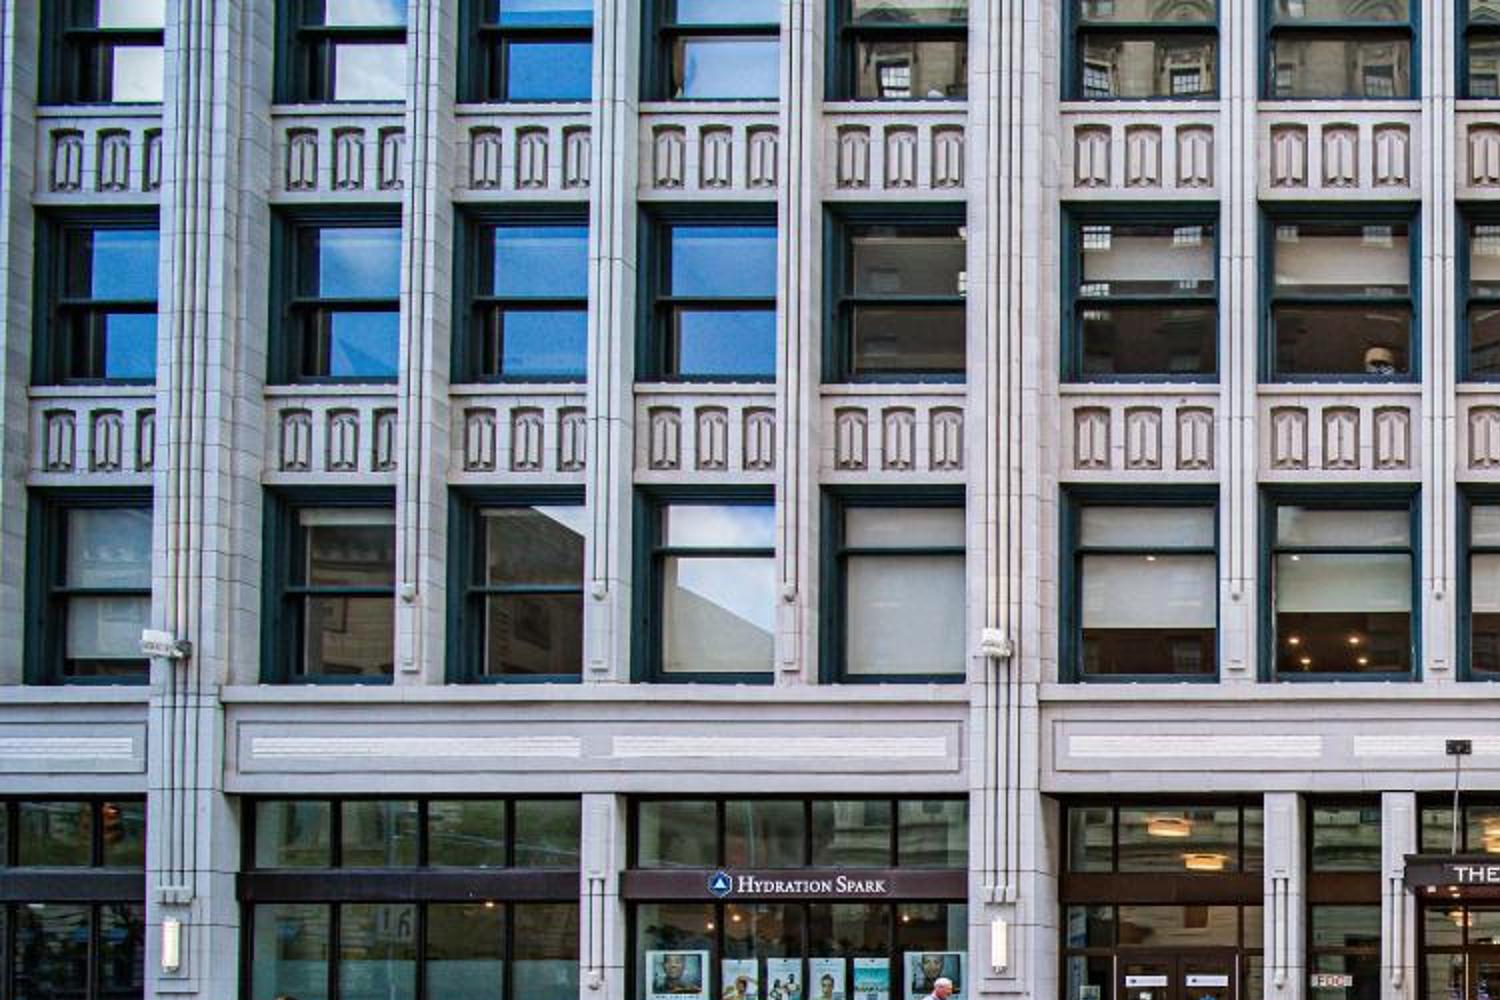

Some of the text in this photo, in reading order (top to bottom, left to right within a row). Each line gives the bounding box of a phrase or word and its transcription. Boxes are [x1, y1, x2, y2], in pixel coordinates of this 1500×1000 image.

[1453, 866, 1500, 882] THE
[737, 875, 886, 893] HYDRATION SPARK
